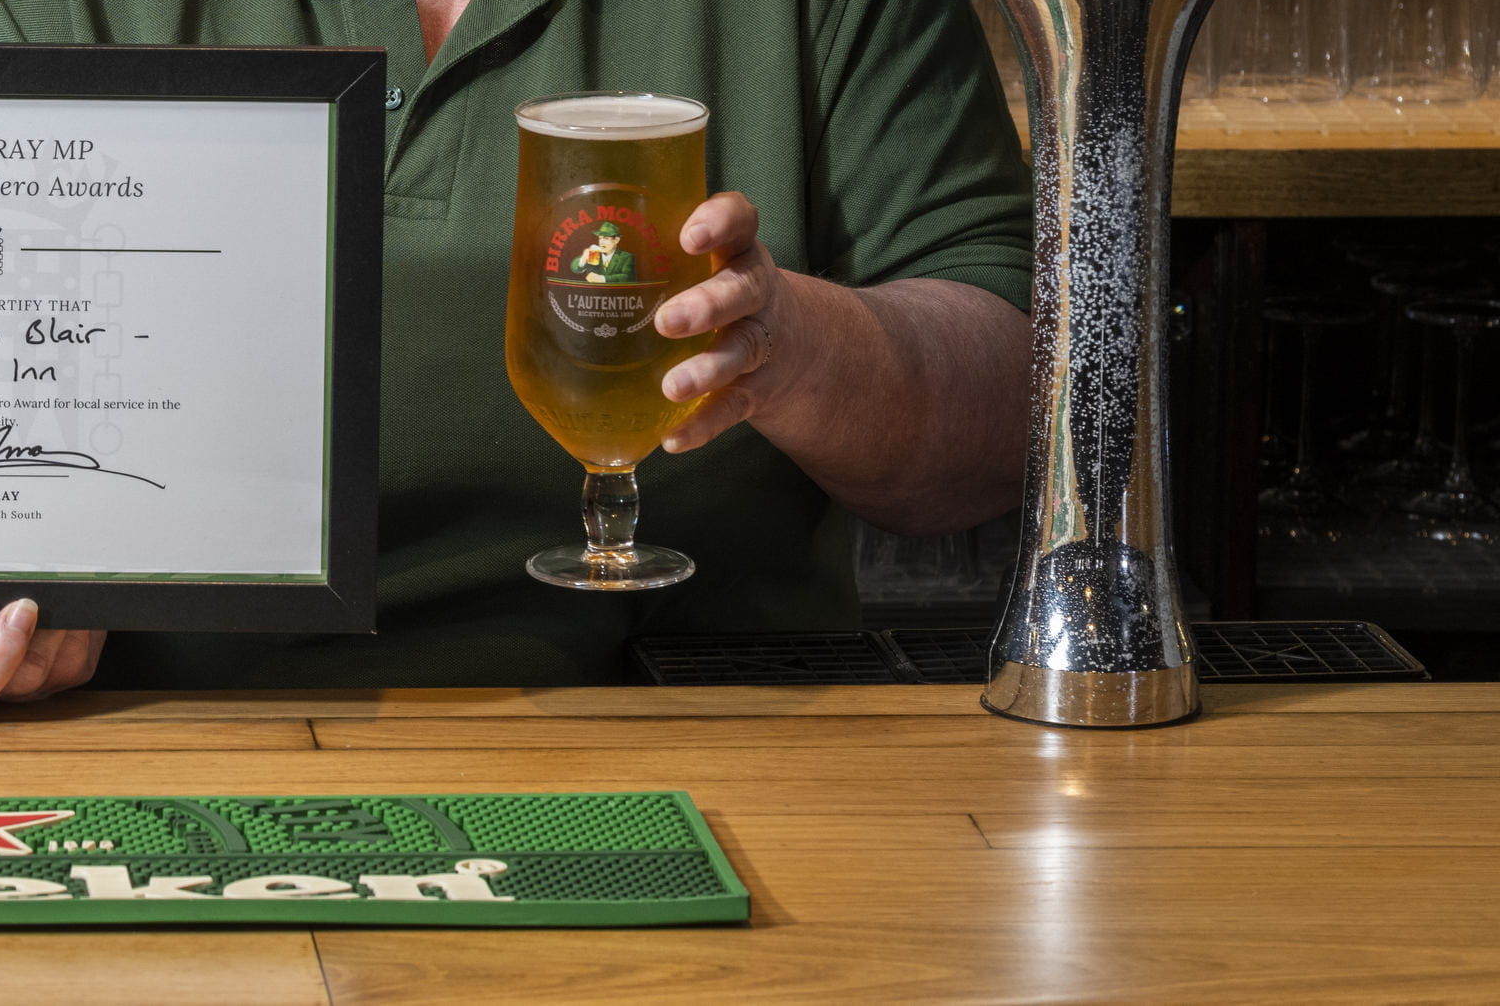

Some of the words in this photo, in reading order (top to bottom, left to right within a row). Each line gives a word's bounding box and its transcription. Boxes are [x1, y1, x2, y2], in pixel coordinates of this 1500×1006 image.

[52, 139, 94, 161] MP
[48, 175, 145, 198] Awards
[546, 209, 593, 272] BIRRA
[48, 299, 92, 312] THAT
[567, 294, 645, 310] L'AUTENTICA
[24, 317, 107, 346] Blair
[13, 357, 57, 382] Inn
[13, 397, 51, 409] Award
[53, 397, 71, 409] for
[73, 397, 101, 410] local
[103, 398, 145, 410] service
[147, 398, 159, 410] in
[162, 398, 181, 410] the
[10, 510, 42, 520] South
